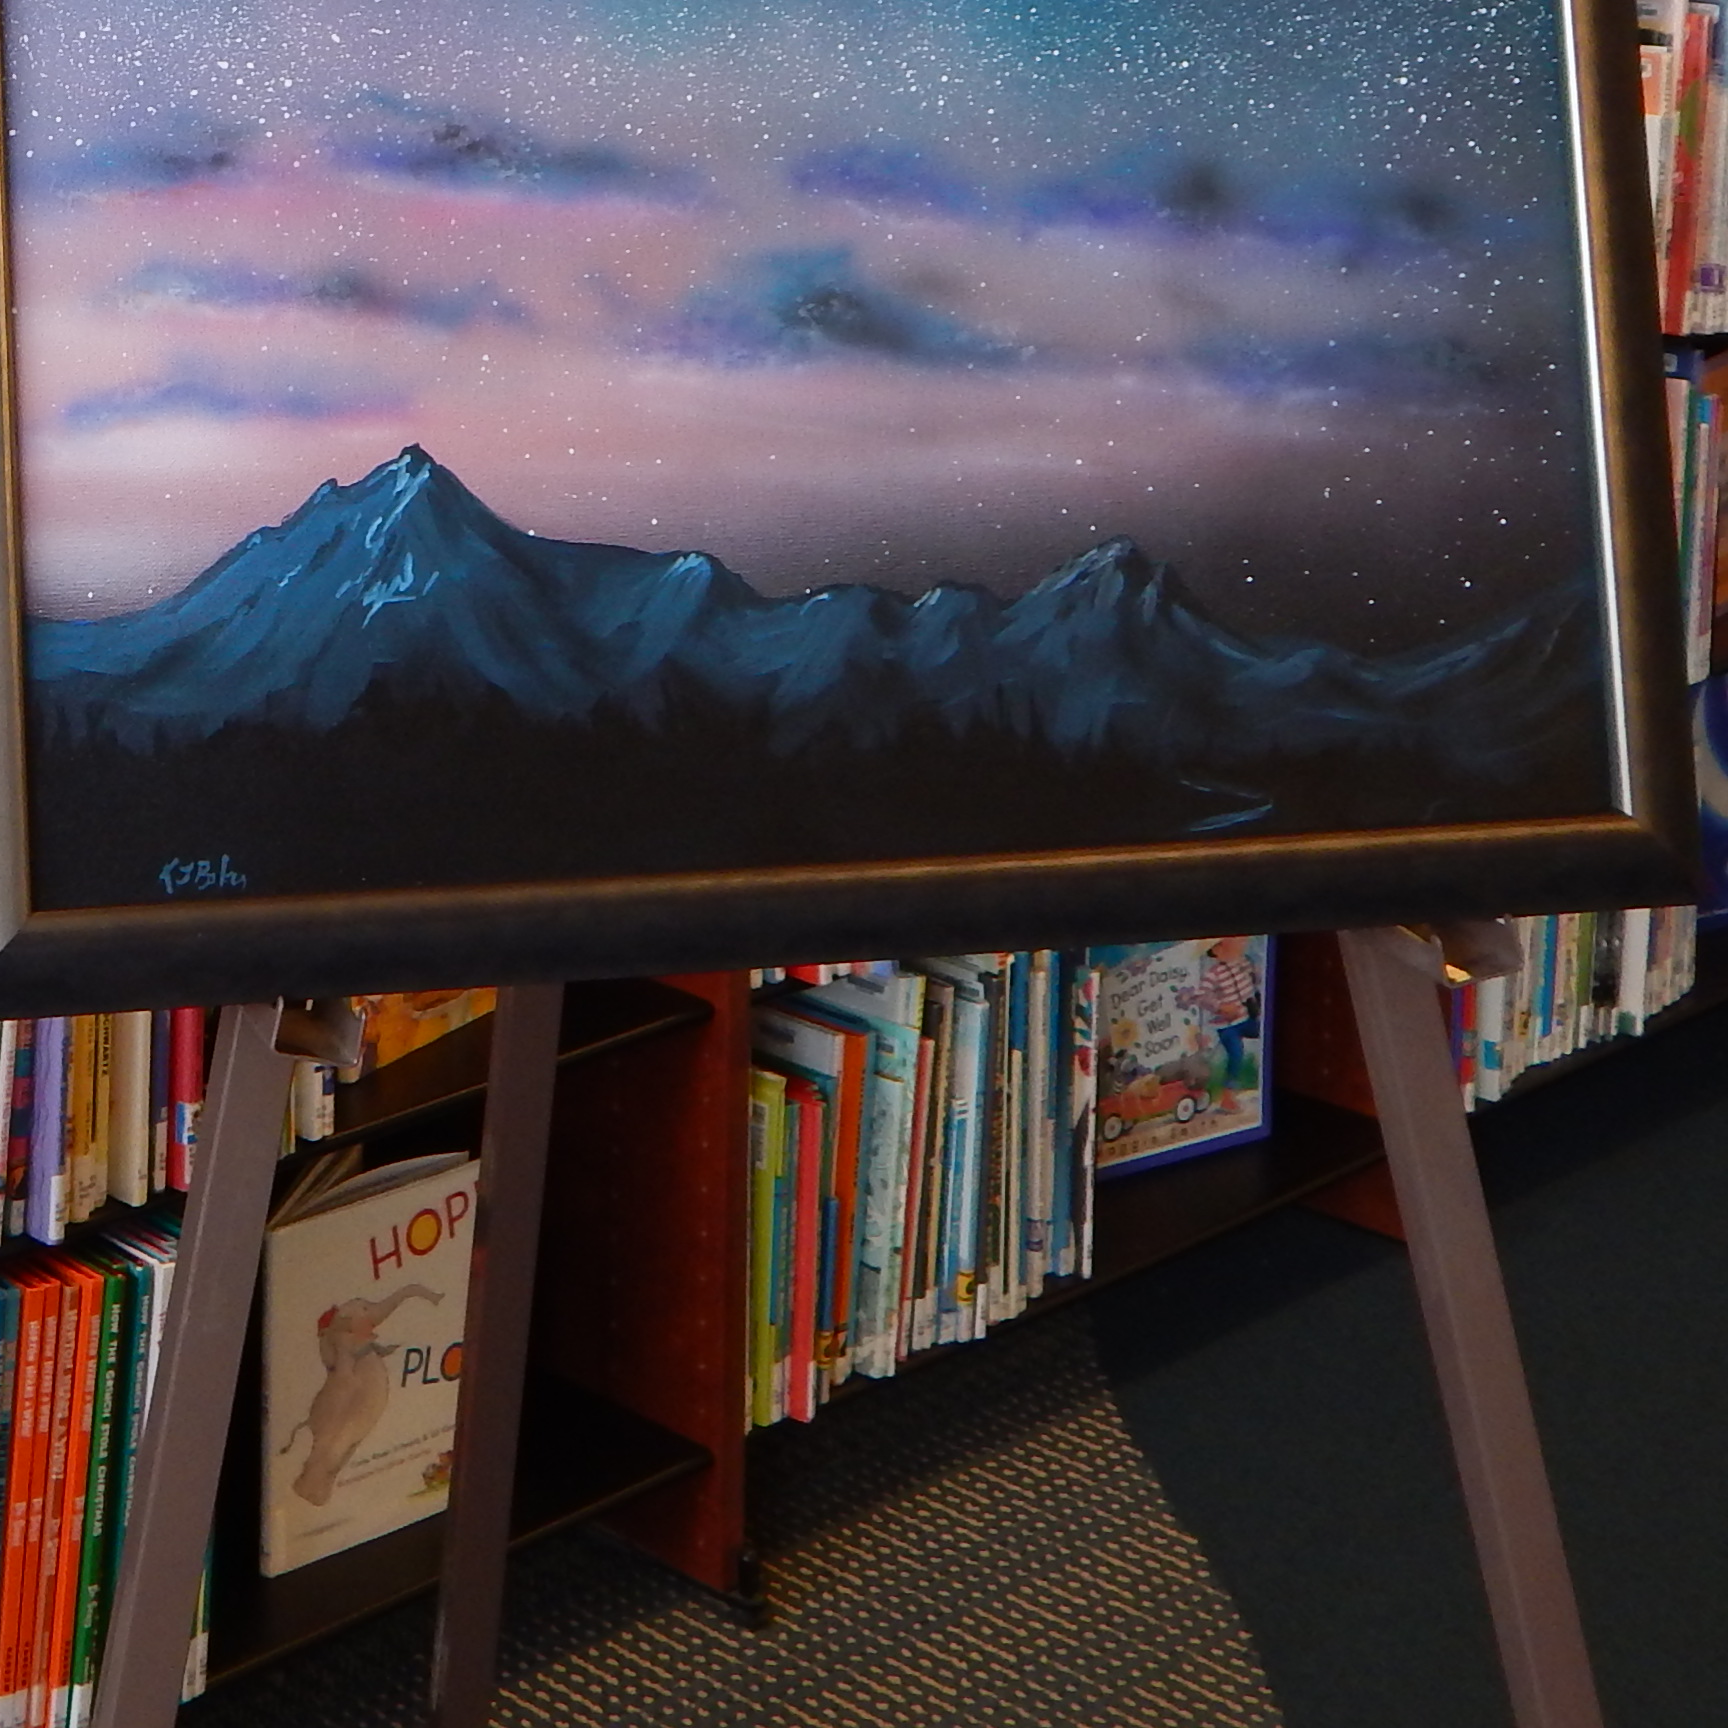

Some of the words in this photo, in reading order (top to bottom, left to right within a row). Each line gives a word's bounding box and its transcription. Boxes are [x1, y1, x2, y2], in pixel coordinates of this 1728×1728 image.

[1110, 978, 1145, 1010] Dear
[1136, 993, 1164, 1018] Get
[110, 1303, 121, 1333] HOW
[107, 1341, 118, 1363] THE
[401, 1341, 464, 1388] PLO
[102, 1370, 116, 1418] GRINCH
[99, 1423, 111, 1459] STOLE
[92, 1465, 108, 1537] CHRISTMAS
